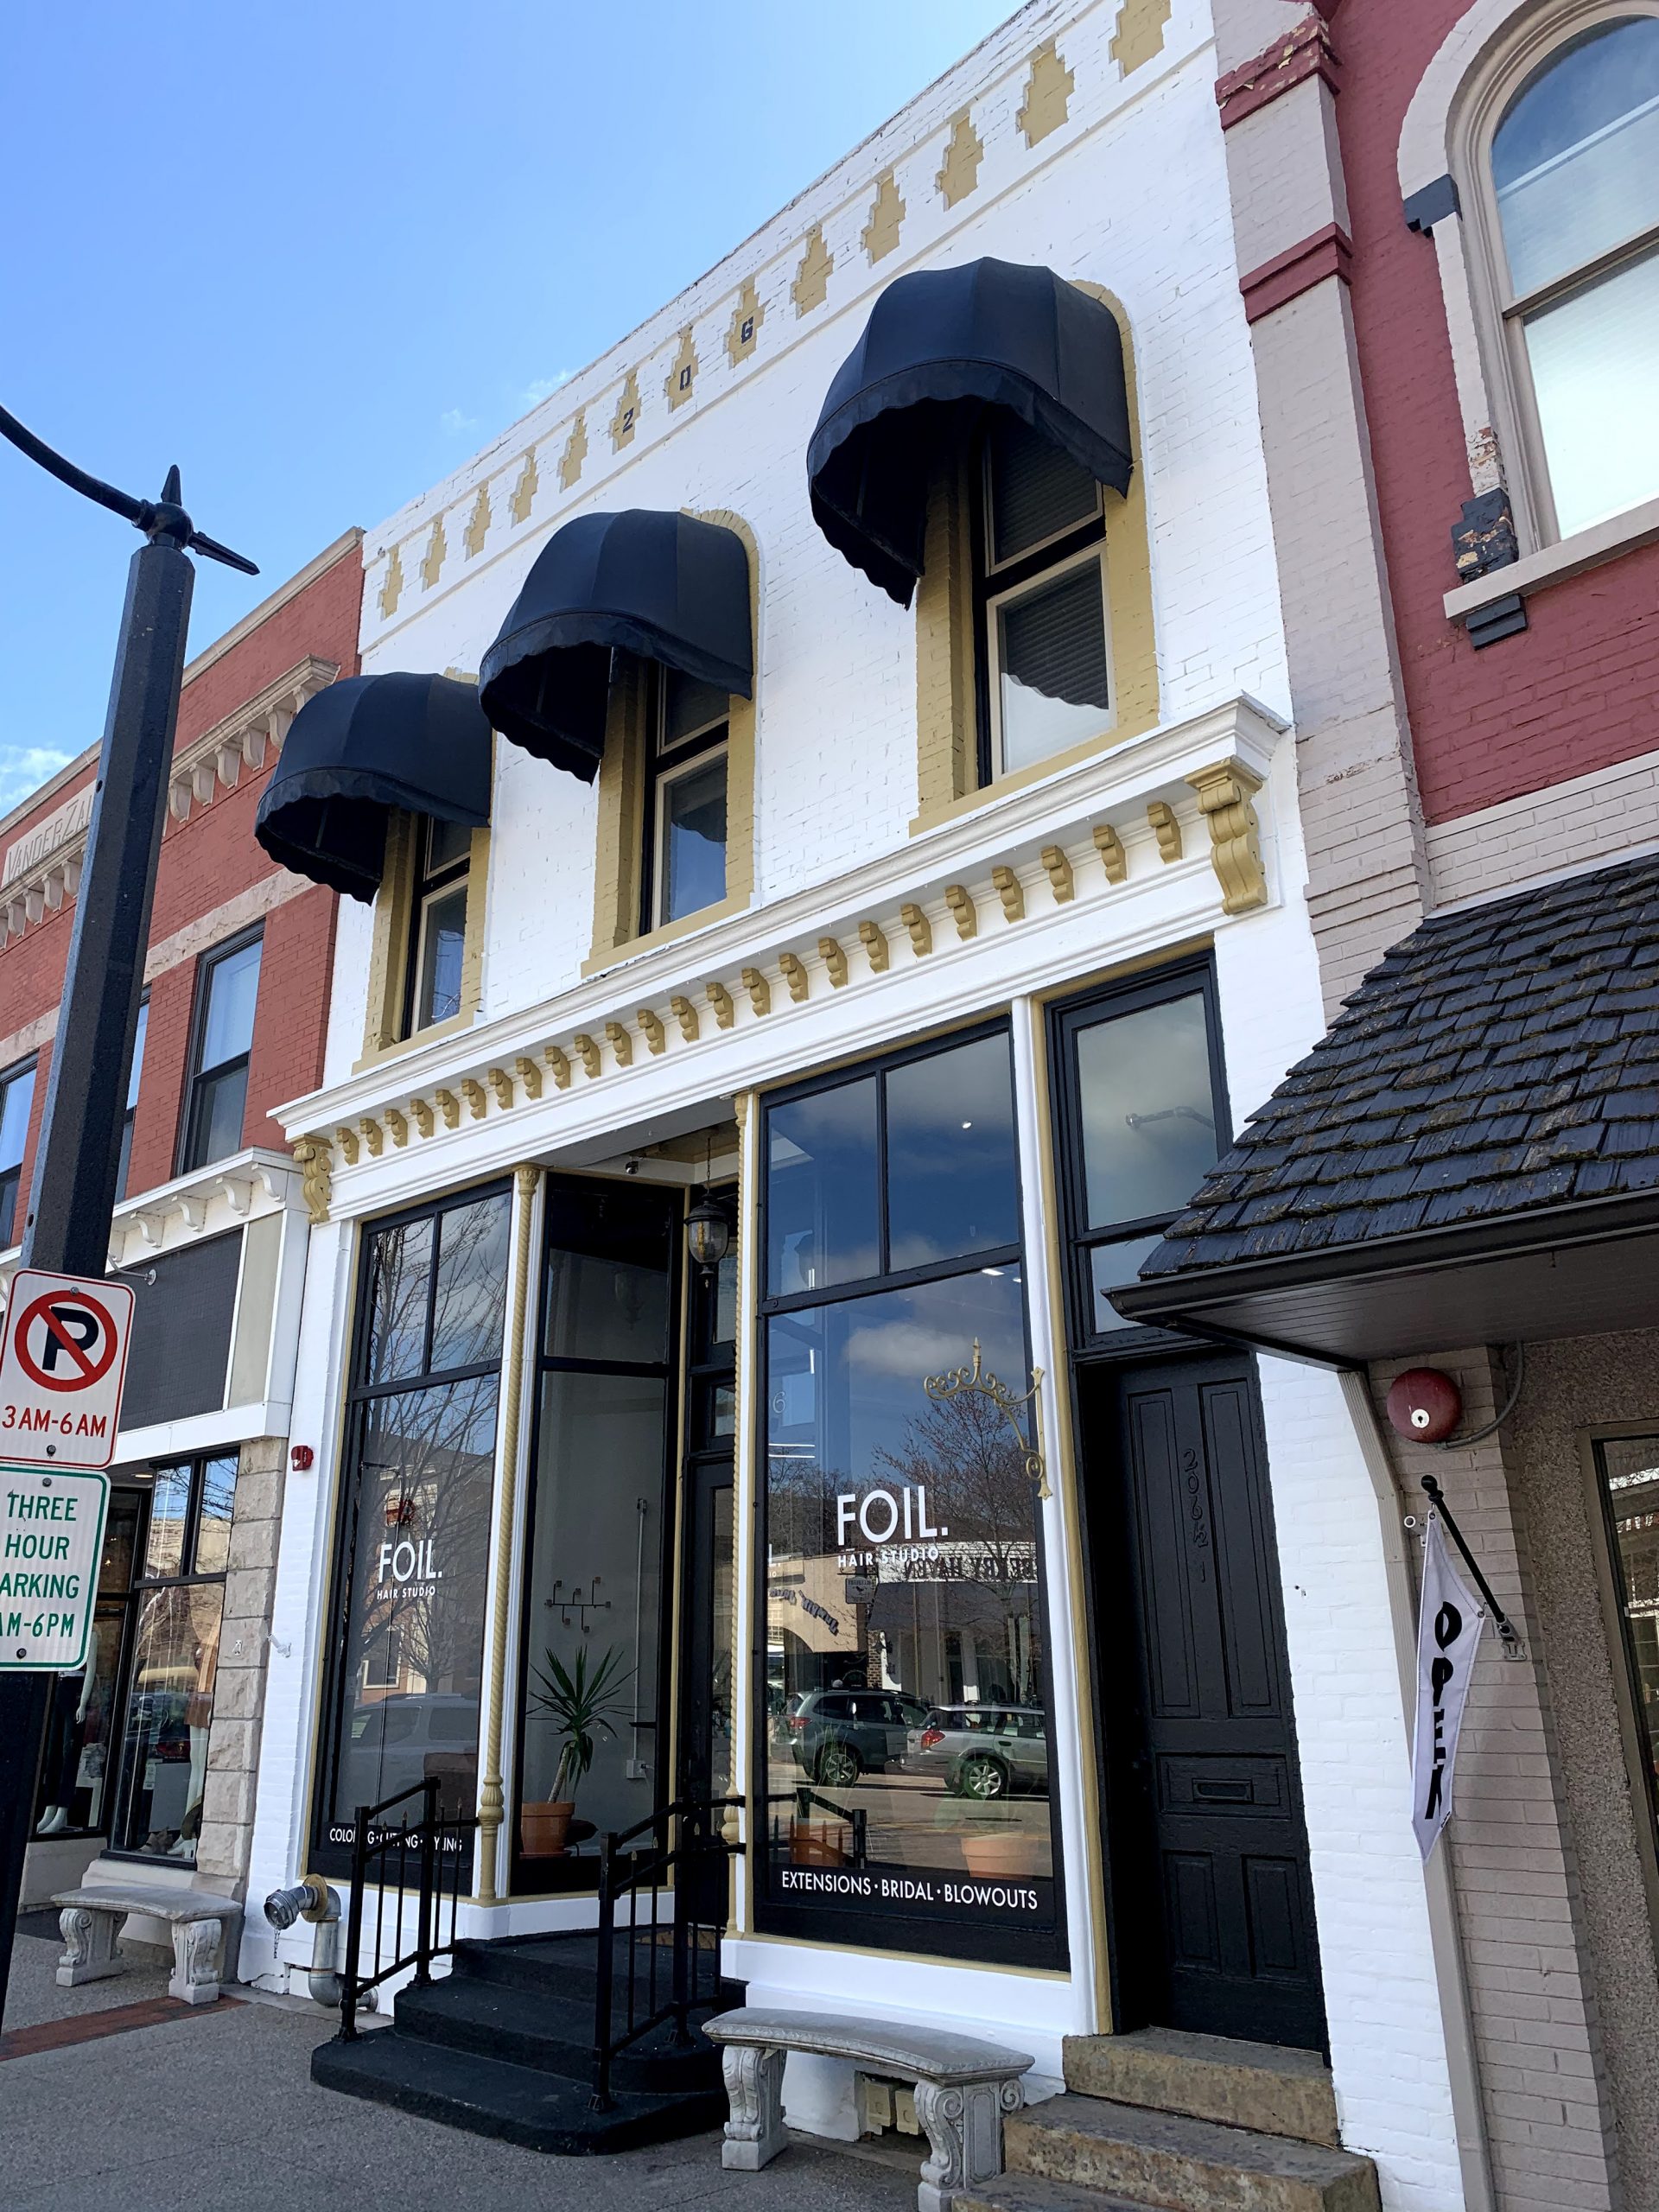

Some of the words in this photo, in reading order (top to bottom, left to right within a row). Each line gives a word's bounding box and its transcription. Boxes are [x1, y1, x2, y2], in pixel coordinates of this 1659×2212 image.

[2, 1405, 108, 1438] 3AM-6AM
[7, 1493, 79, 1522] THREE
[837, 1485, 949, 1547] FOIL.
[5, 1533, 70, 1560] HOUR
[378, 1539, 443, 1583] FOIL.
[837, 1553, 874, 1568] HAIR
[881, 1546, 939, 1565] STUDIO
[0, 1573, 79, 1599] ARKING
[377, 1589, 399, 1600] HAIR
[402, 1586, 436, 1599] STUDIO
[781, 1871, 872, 1896] EXTENSIONS
[881, 1878, 934, 1901] BRIDAL
[944, 1884, 1038, 1910] BLOWOUTS
